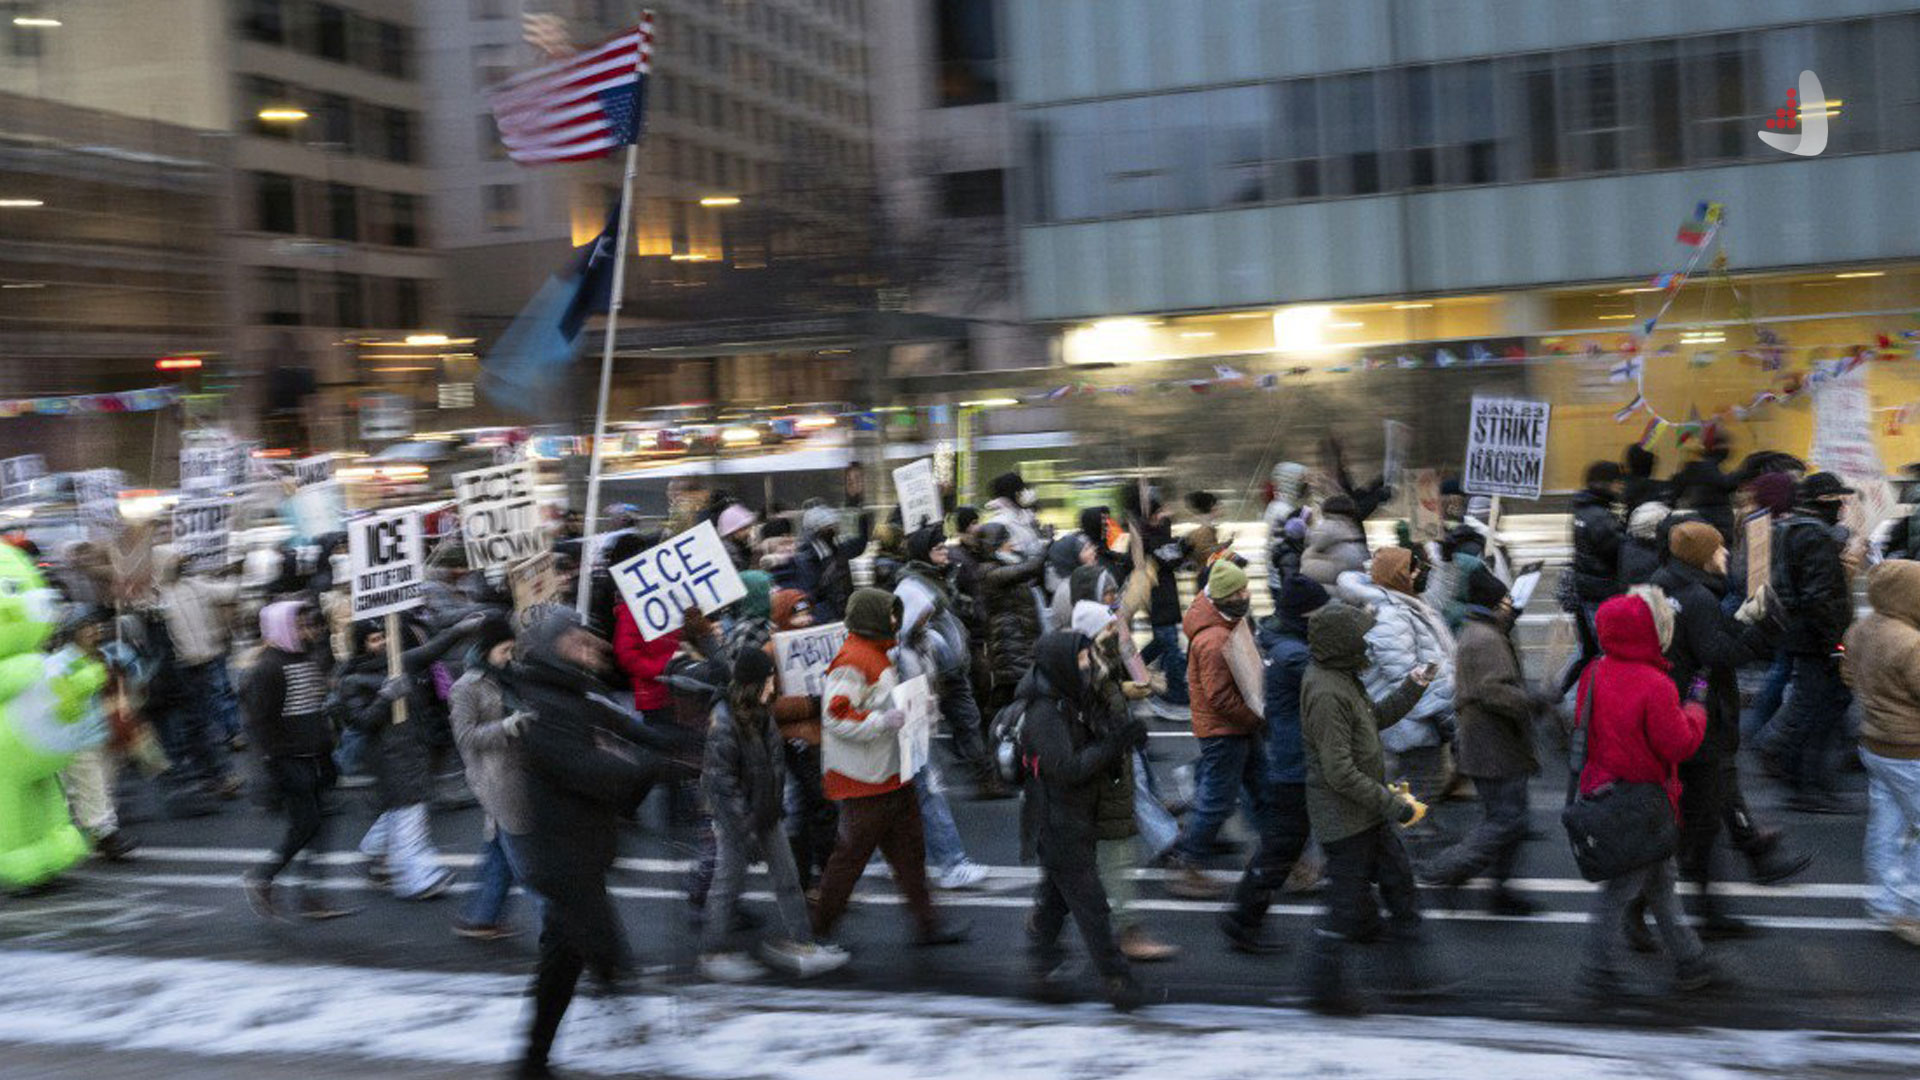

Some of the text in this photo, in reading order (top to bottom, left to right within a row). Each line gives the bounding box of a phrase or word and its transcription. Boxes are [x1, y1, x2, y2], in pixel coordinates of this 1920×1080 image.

[1474, 416, 1544, 448] STRIKE
[466, 468, 527, 504] ICE
[1469, 453, 1541, 485] RACISM
[466, 501, 537, 538] OUT
[366, 518, 409, 568] ICE
[623, 536, 712, 598] ICE
[644, 568, 720, 631] OUT
